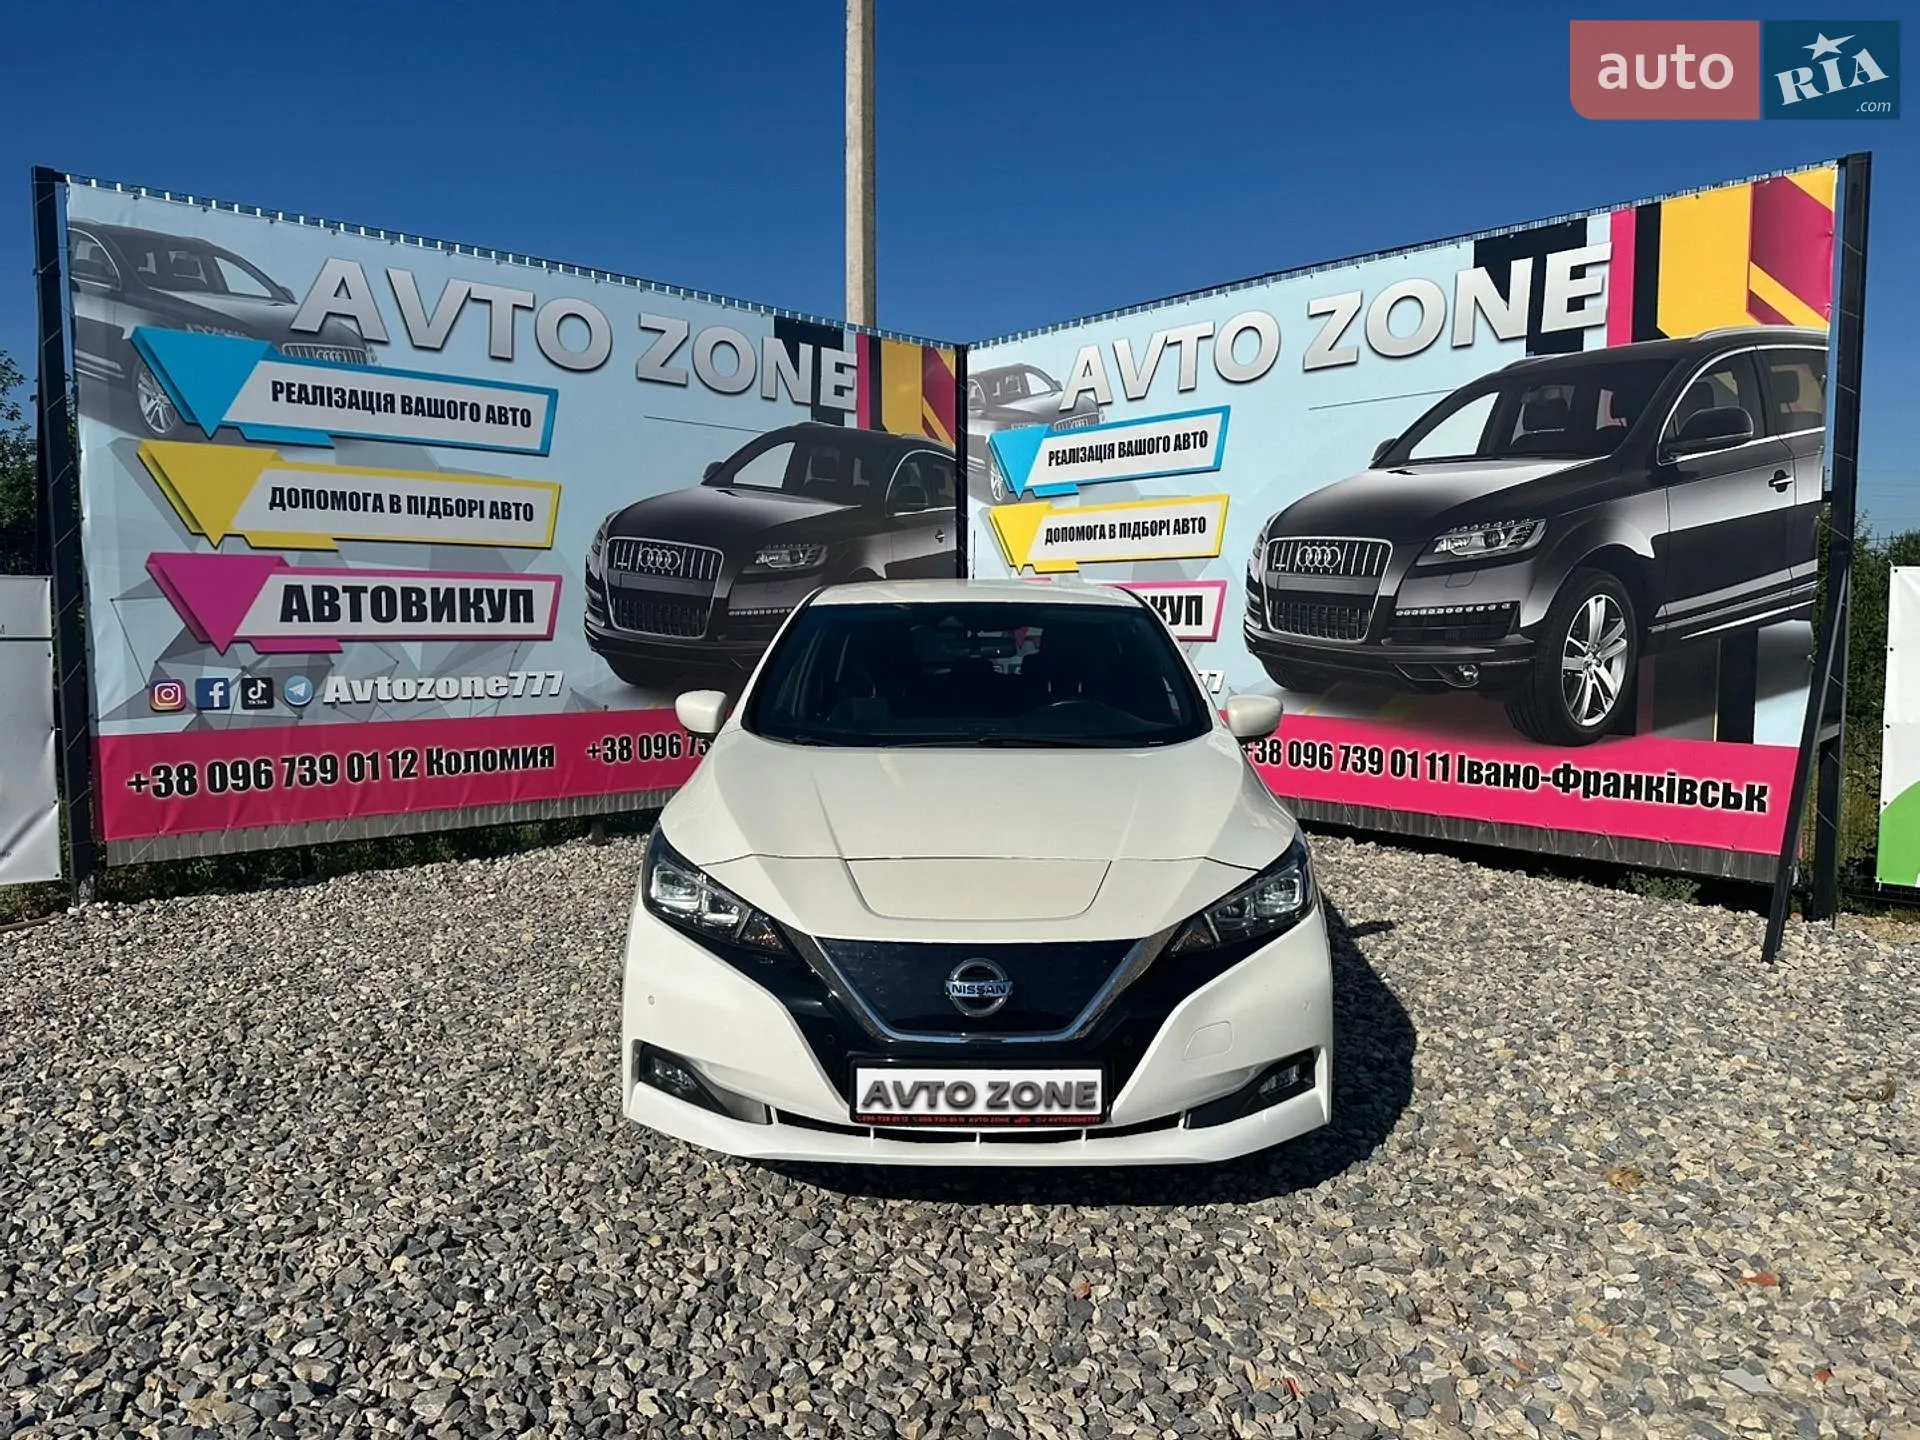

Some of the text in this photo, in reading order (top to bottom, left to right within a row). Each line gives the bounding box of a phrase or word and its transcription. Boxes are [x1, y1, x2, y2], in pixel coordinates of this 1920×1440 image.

[290, 257, 857, 412] AVTO ZONE
[1059, 242, 1612, 410] AVTO ZONE
[271, 379, 532, 428] РЕАЛІЗАЦІЯ ВАШОГО АВТО
[1048, 430, 1208, 467] РЕАЛІЗАЦІЯ ВАШОГО АВТО
[269, 486, 535, 521] ДОПОМОГА В ПІДБОРІ АВТО
[1045, 516, 1206, 546] ДОПОМОГА В ПІДБОРІ АВТО
[280, 584, 535, 625] АВТОВИКУП
[1143, 595, 1203, 626] КУП
[322, 671, 564, 704] Avtozone777
[587, 736, 632, 763] +38
[638, 733, 682, 761] 096
[127, 745, 555, 798] +38 096 739 01 12 Коломия
[1288, 740, 1334, 771] 096
[1339, 745, 1384, 776] 739
[1390, 749, 1419, 779] 01
[1424, 752, 1450, 782] 11
[1457, 754, 1768, 813] Івано-Франківськ
[951, 984, 1007, 995] NISSAN
[861, 1080, 1097, 1110] AVTO ZONE
